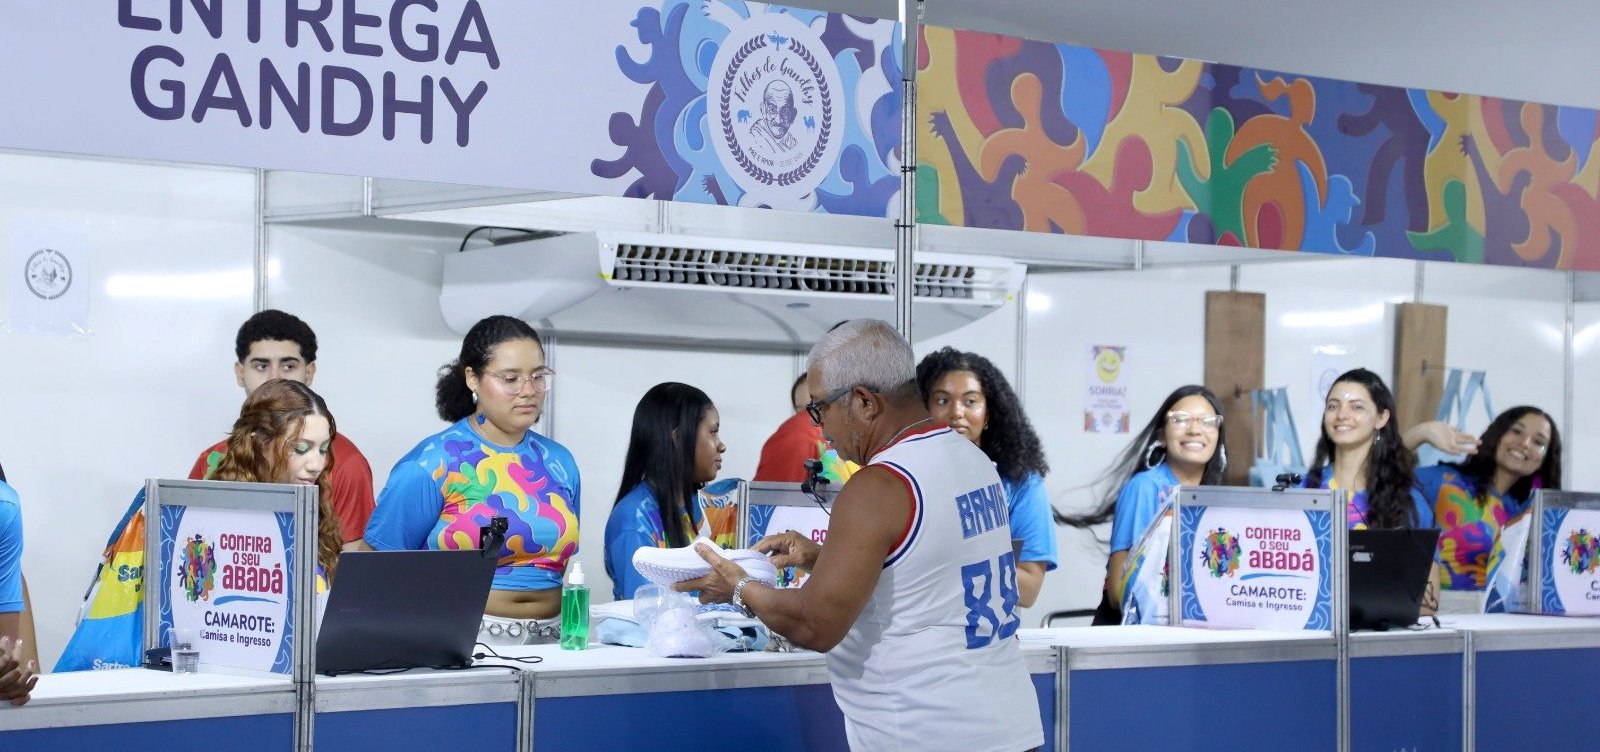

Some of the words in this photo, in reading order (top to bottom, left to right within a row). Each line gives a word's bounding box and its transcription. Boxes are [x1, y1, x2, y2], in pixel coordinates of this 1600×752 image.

[130, 45, 488, 148] GANDHY
[1230, 584, 1307, 601] CAMAROTE:
[1226, 598, 1256, 608] Camisa
[1266, 602, 1303, 612] Ingresso
[204, 610, 275, 633] CAMAROTE:
[229, 633, 235, 642] e
[236, 635, 271, 647] Ingresso
